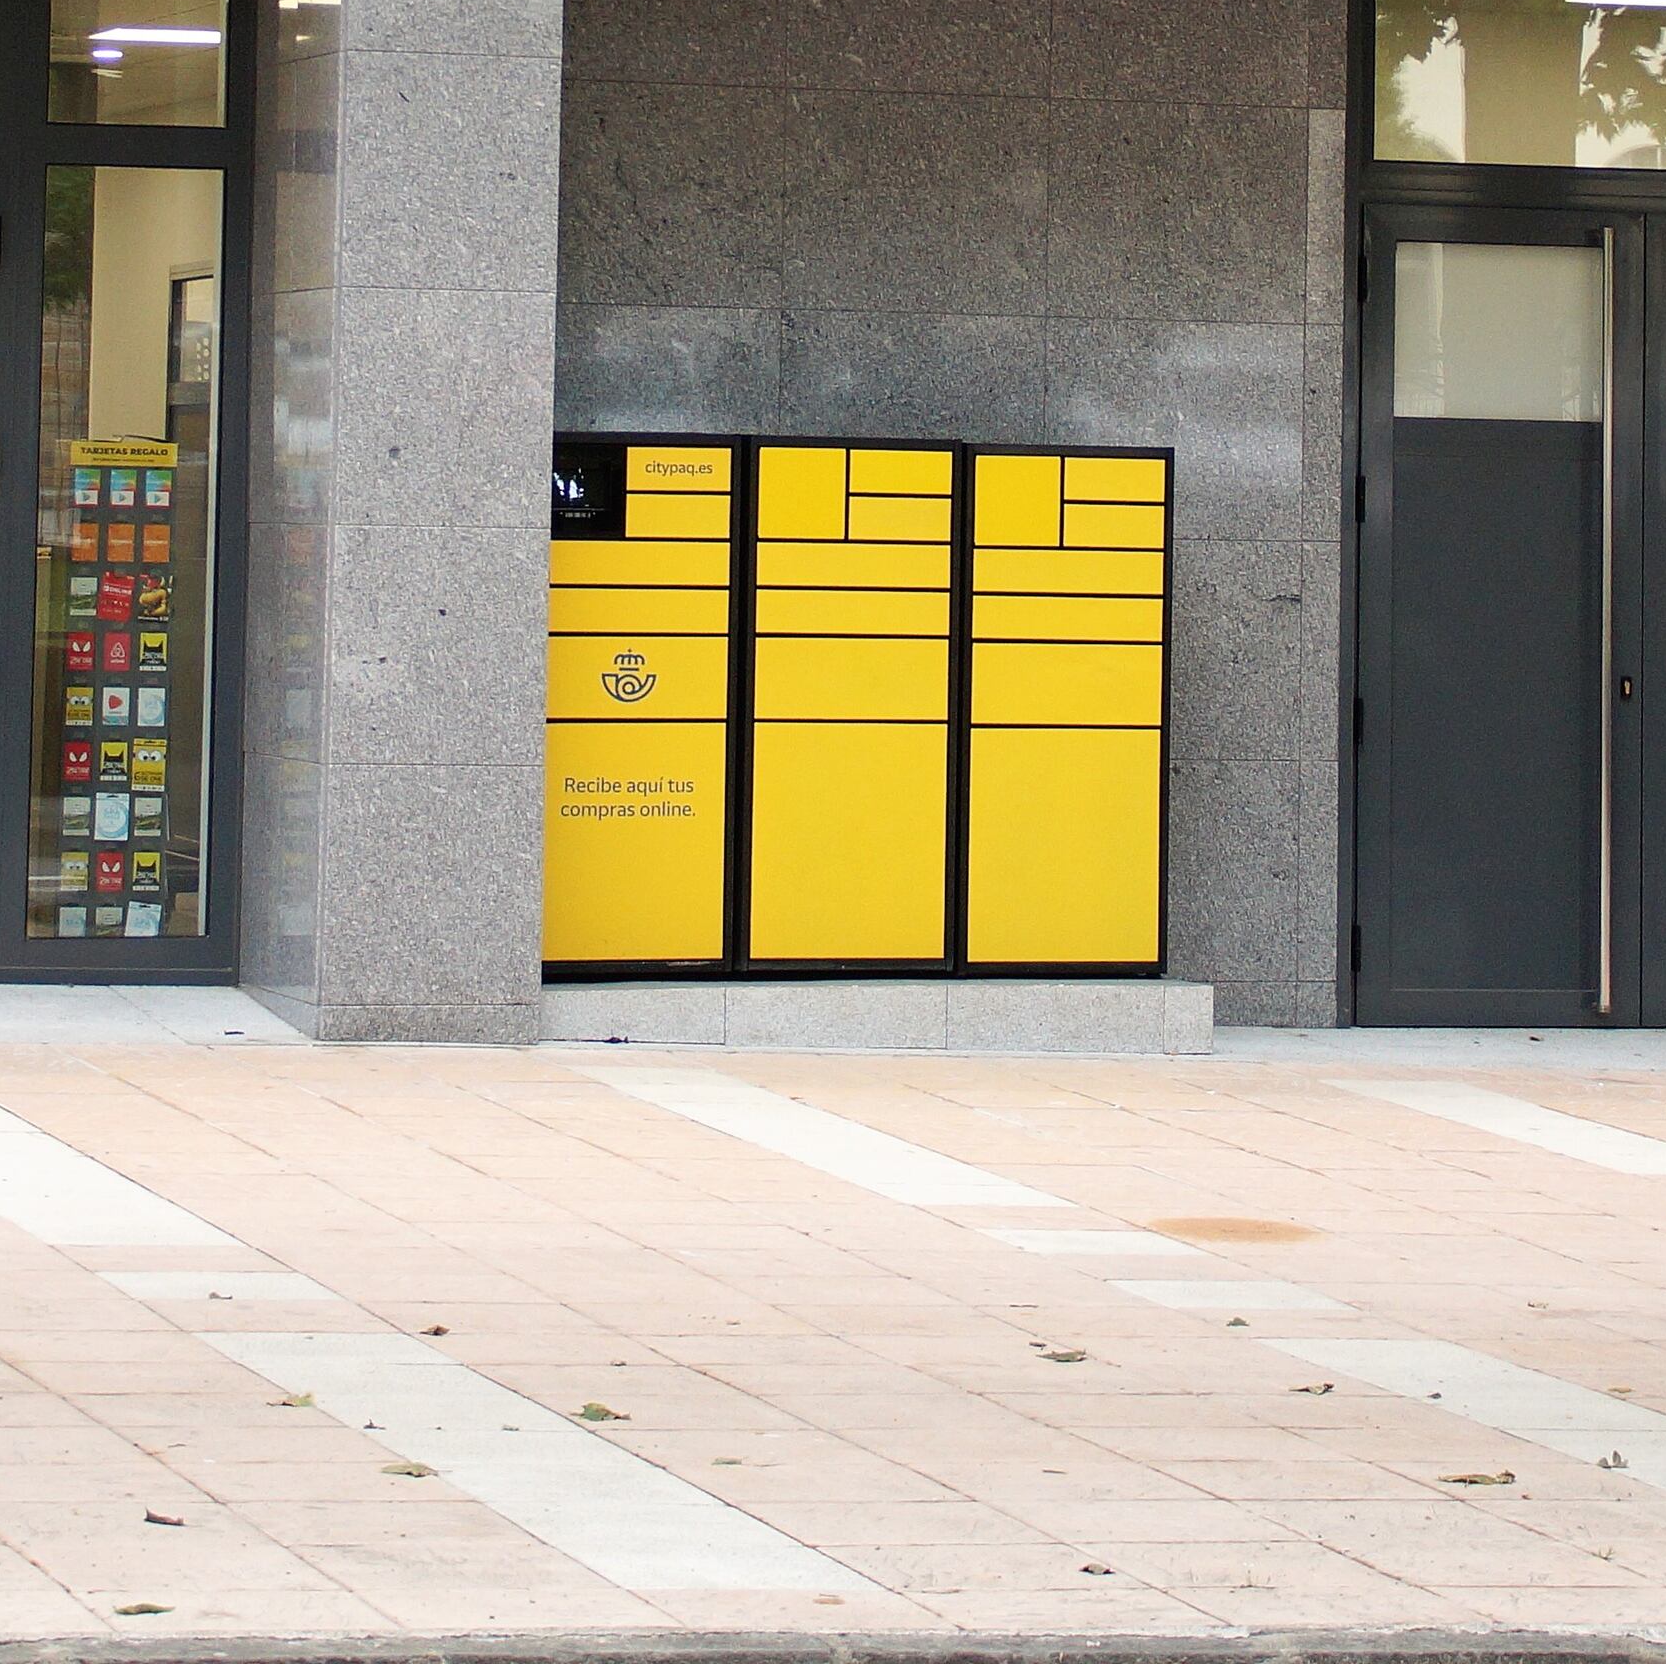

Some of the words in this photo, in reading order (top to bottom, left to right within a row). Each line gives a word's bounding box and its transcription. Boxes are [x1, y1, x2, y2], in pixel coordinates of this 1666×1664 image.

[80, 447, 128, 455] TARJETAS
[130, 448, 168, 456] REGALO
[645, 460, 713, 477] citypaq.es
[564, 777, 622, 793] Recibe
[626, 776, 664, 797] aquí
[668, 779, 694, 793] tus
[560, 804, 635, 821] compras
[639, 801, 696, 817] online.
